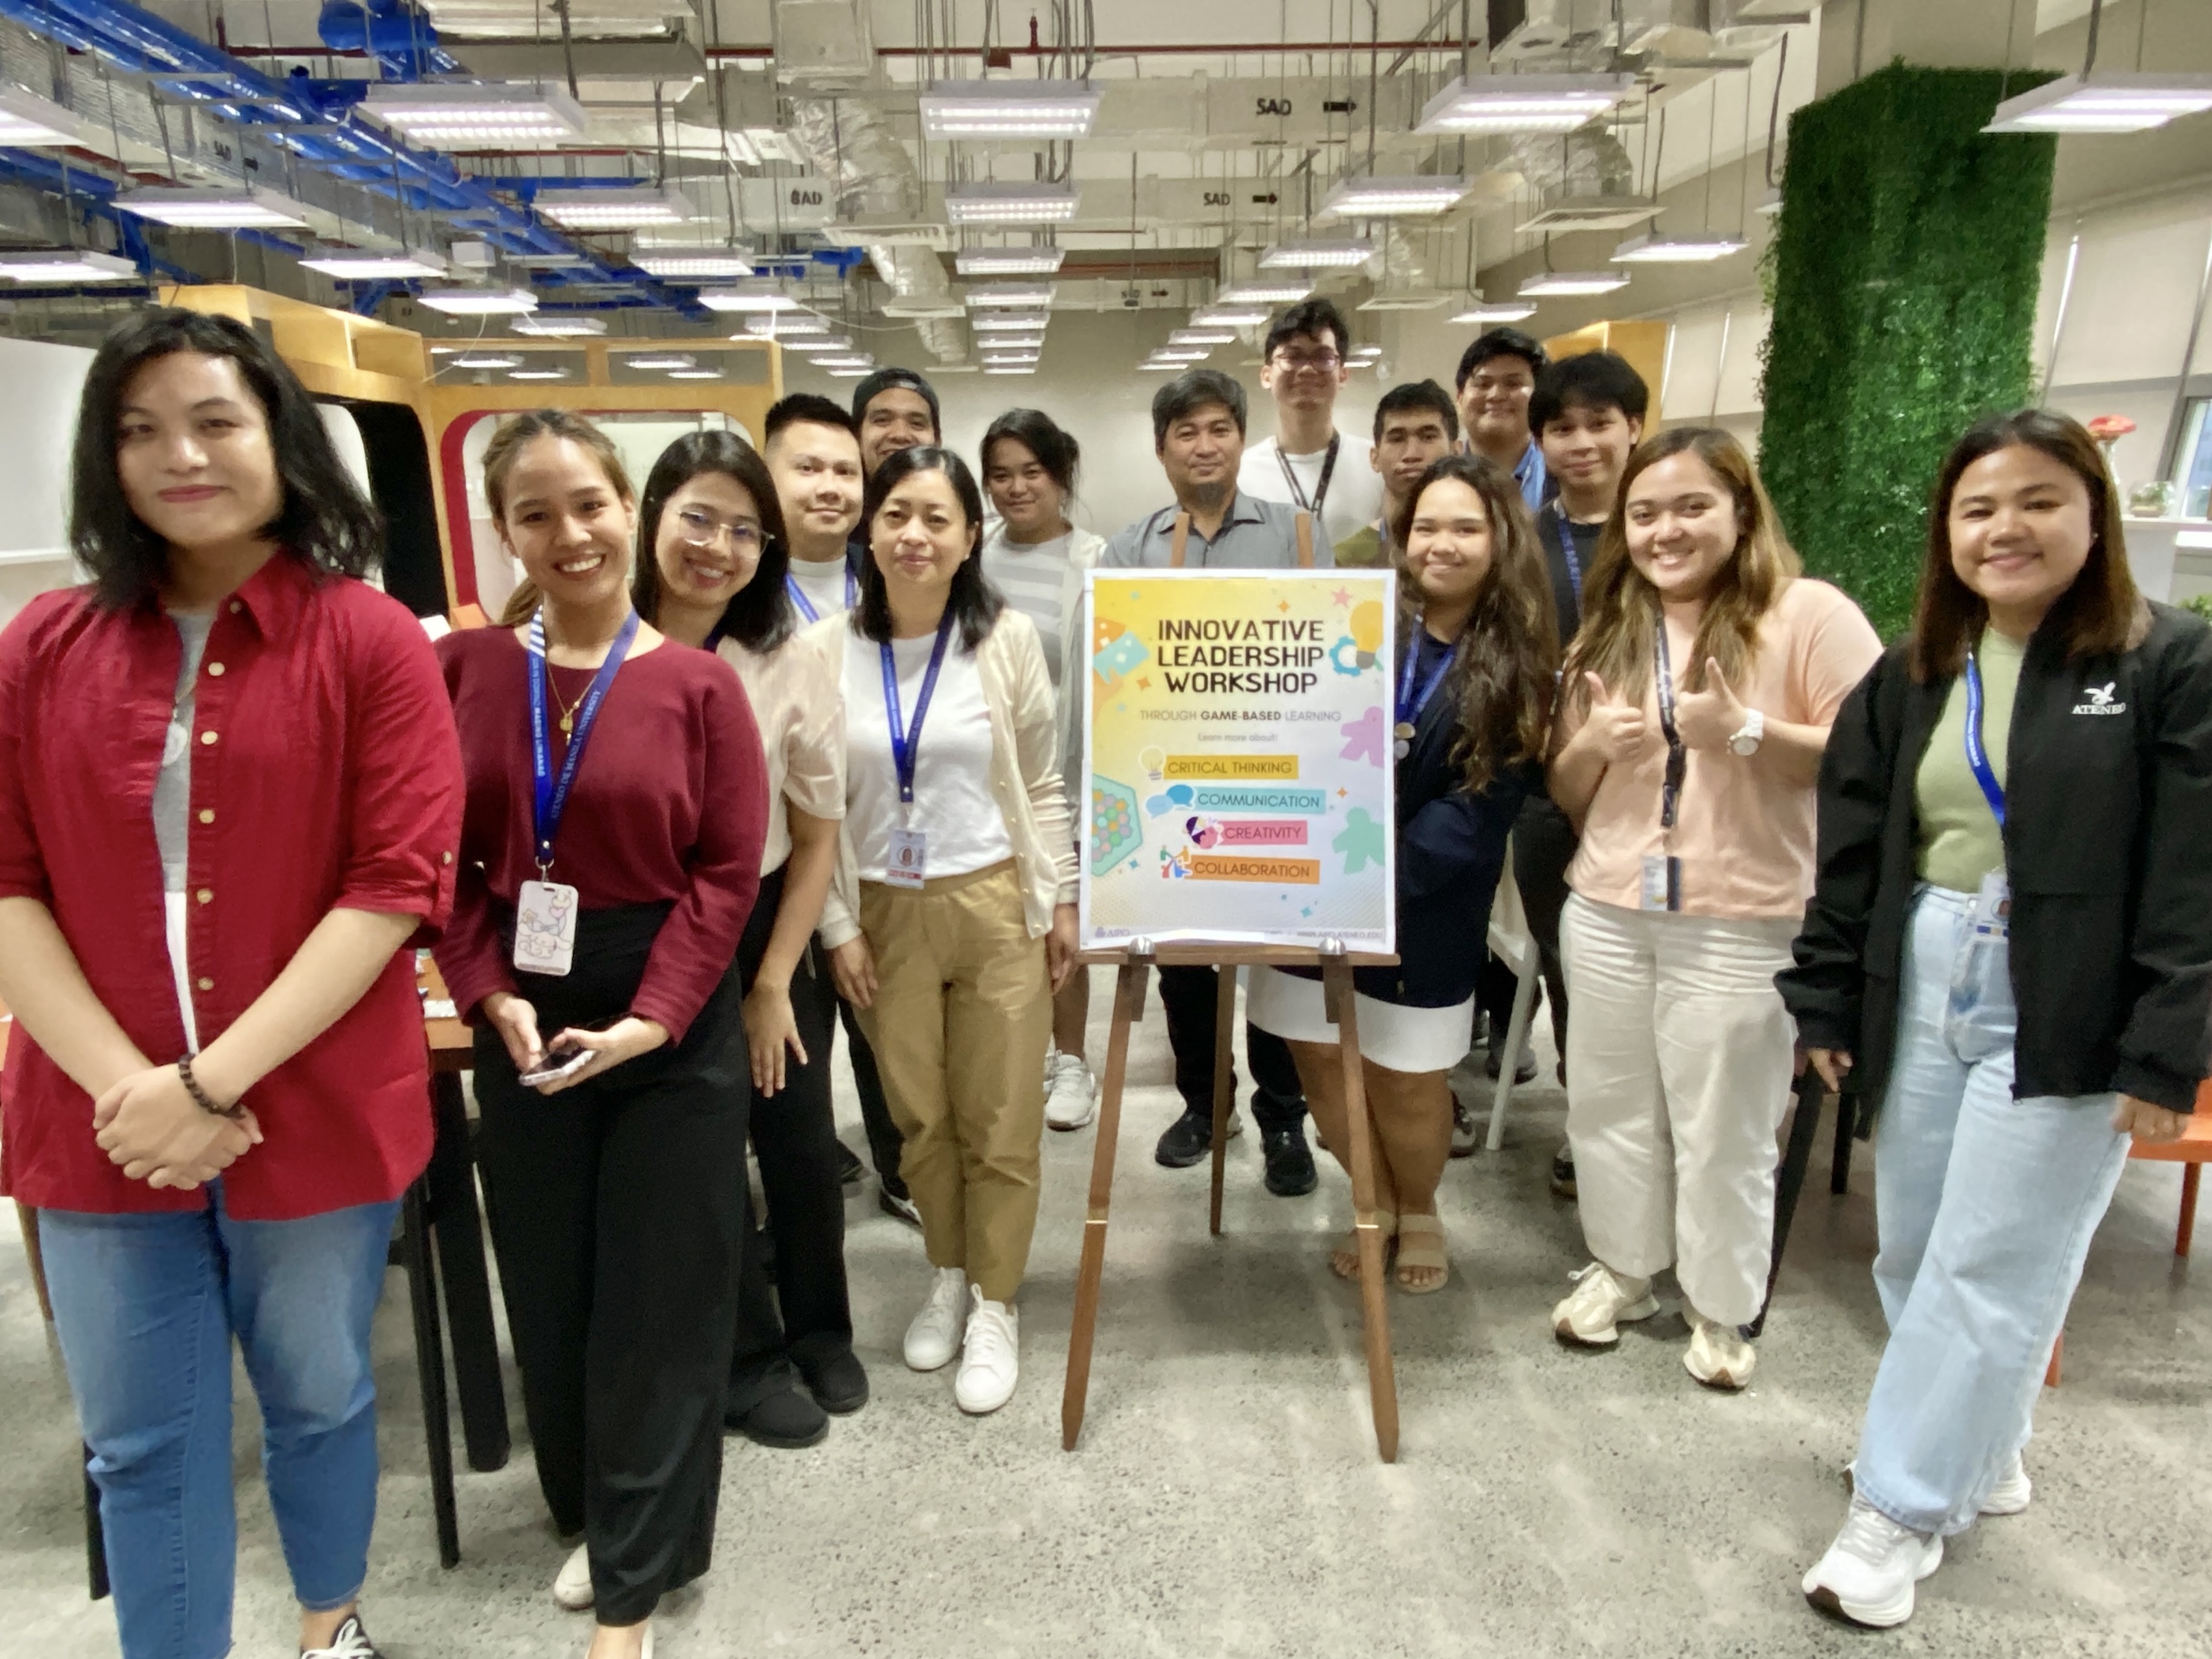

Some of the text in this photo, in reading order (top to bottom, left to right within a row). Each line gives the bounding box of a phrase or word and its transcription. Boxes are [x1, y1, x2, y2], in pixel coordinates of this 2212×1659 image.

[1256, 98, 1292, 116] SAD
[1203, 192, 1231, 206] SAD
[1158, 619, 1324, 641] INNOVATIVE
[1158, 646, 1324, 668] LEADERSHIP
[1165, 672, 1318, 694] WORKSHOP
[1140, 710, 1342, 722] THROUGH GAME-BASED LEARNING
[1167, 761, 1293, 775] CRITICAL THINKING
[1197, 793, 1320, 809] COMMUNICATION
[1224, 825, 1303, 839] CREATIVITY
[1194, 862, 1310, 878] COLLABORATION
